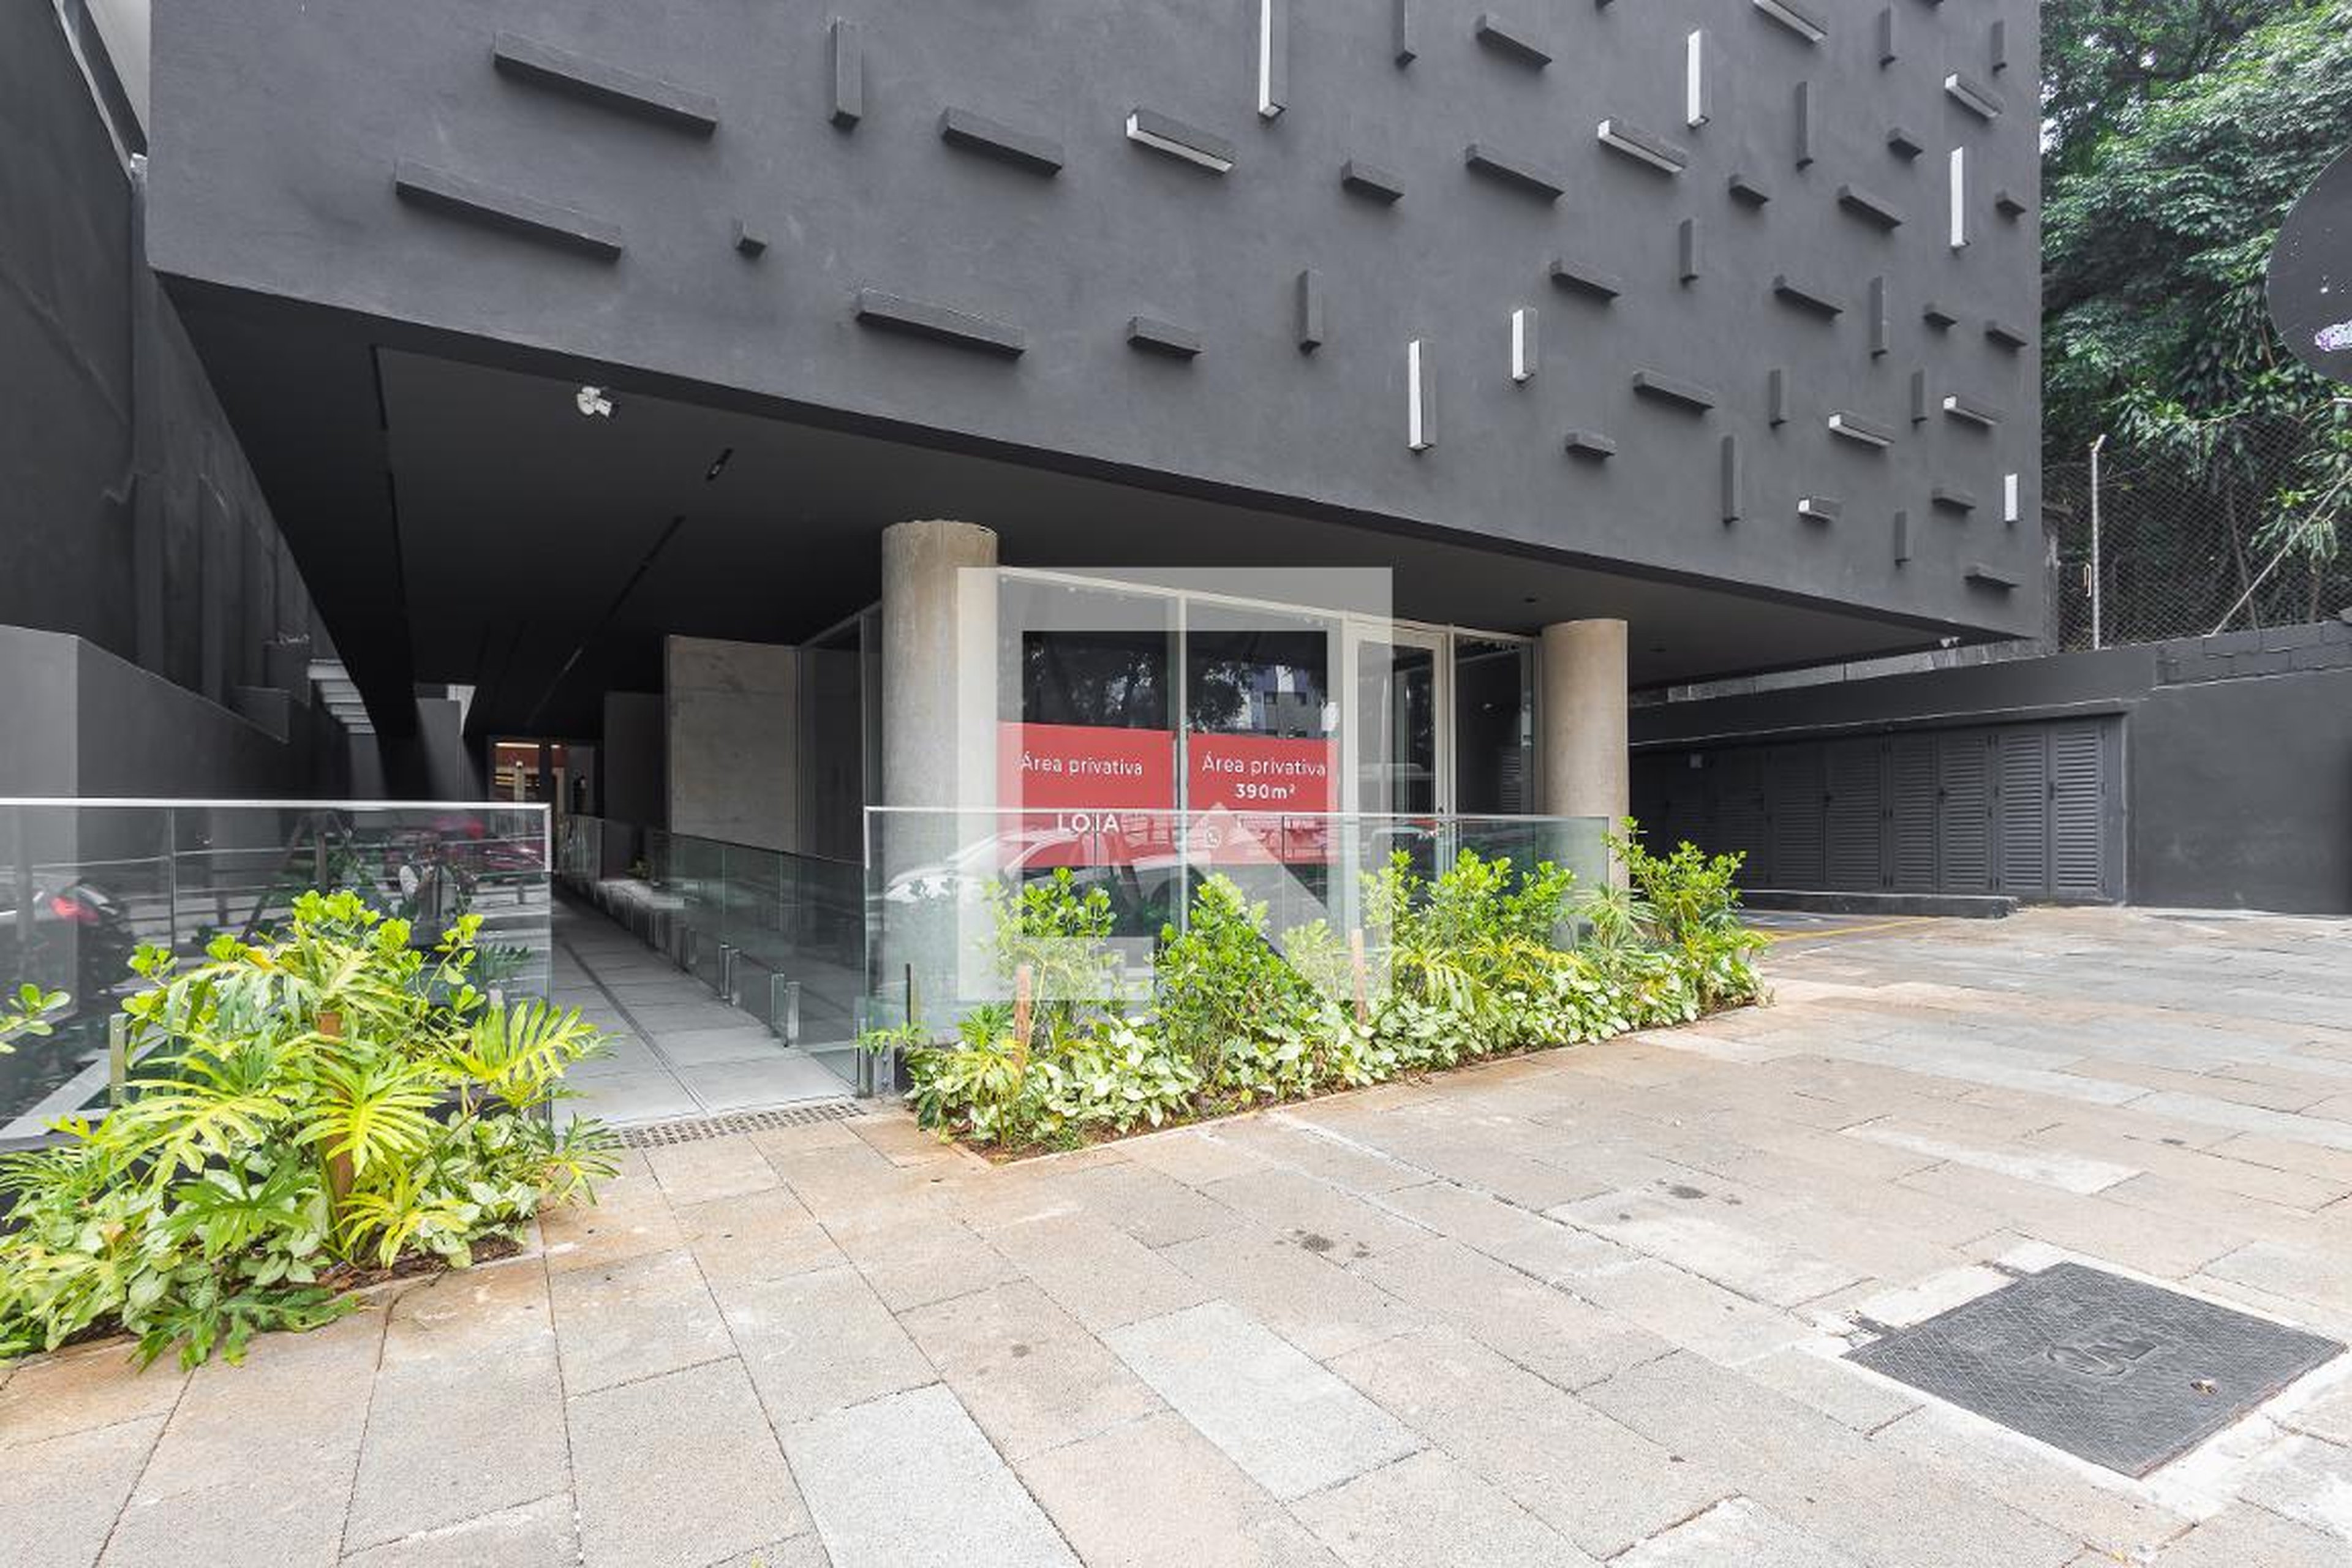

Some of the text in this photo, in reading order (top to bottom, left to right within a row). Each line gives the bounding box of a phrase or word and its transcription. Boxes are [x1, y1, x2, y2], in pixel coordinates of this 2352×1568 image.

[1020, 751, 1142, 776] Área privativa
[1202, 751, 1325, 777] Área privativa
[1235, 783, 1295, 799] 390m²
